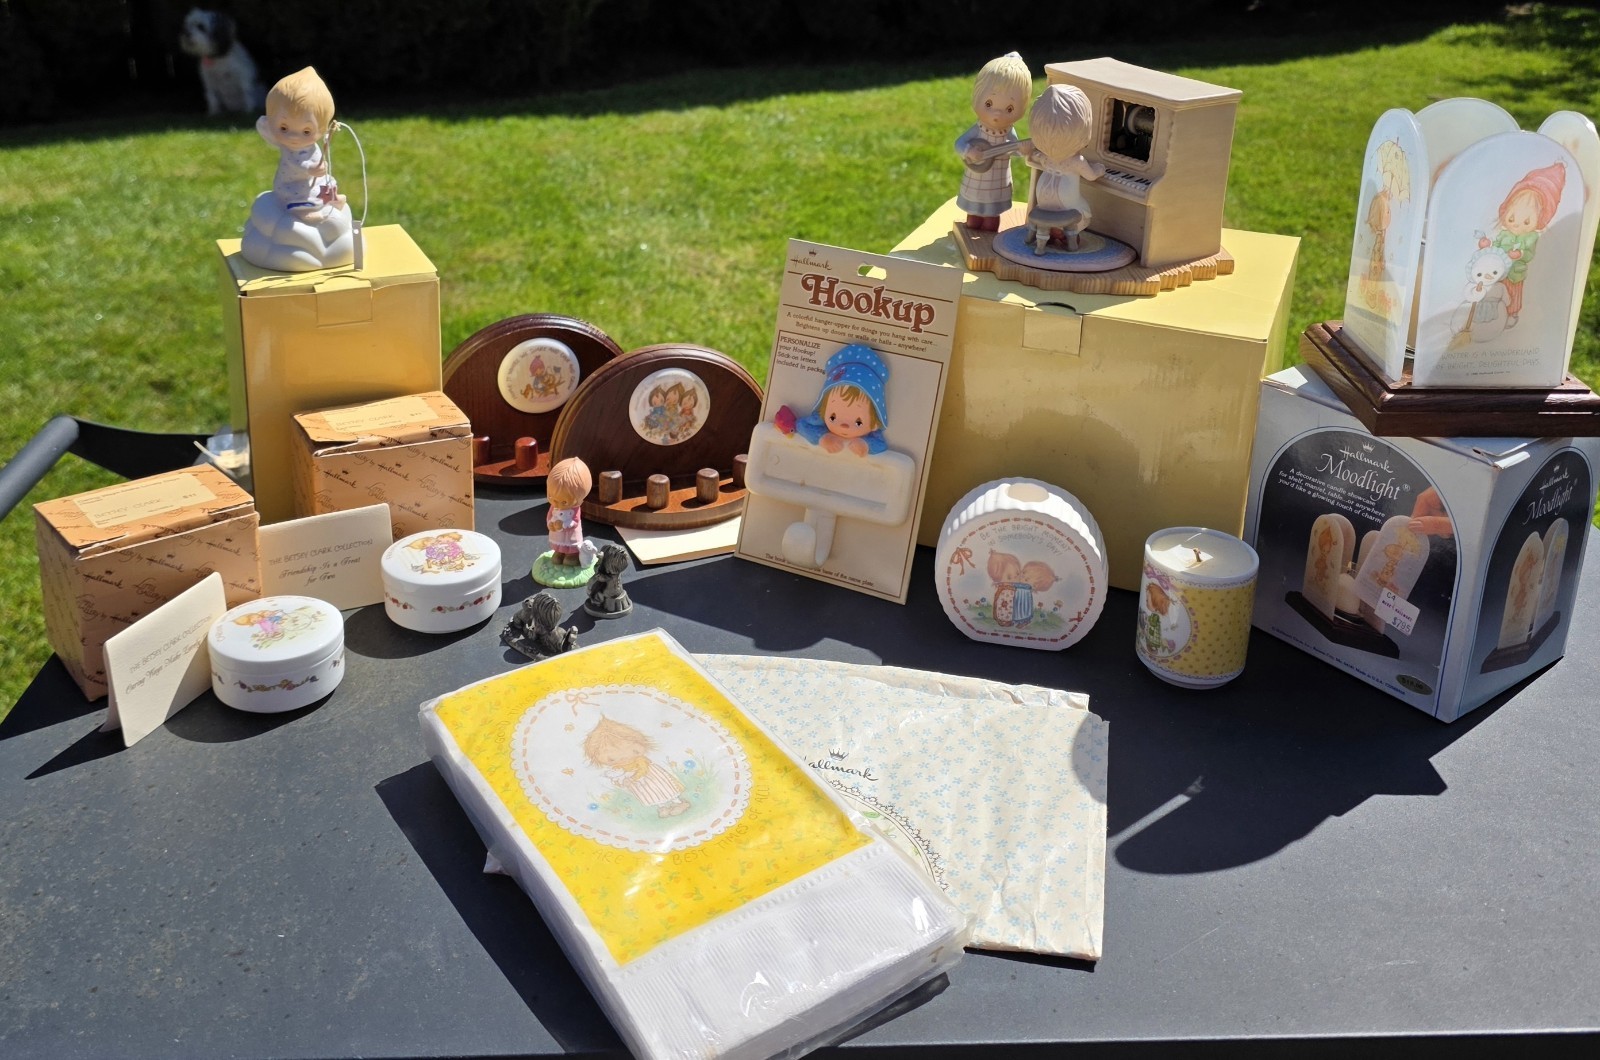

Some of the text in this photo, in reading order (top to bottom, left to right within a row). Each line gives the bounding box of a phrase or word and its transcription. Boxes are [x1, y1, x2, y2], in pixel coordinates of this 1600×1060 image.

[790, 256, 832, 270] Hallmark
[801, 273, 936, 333] Hookup
[792, 313, 814, 321] colorful
[860, 326, 878, 335] things
[891, 332, 905, 341] hang
[780, 336, 822, 350] PERSONALIZE
[806, 366, 826, 375] packag
[429, 455, 460, 473] Hallmark
[1339, 445, 1394, 473] Hallmark
[323, 469, 357, 489] Hallmark
[377, 463, 410, 481] Hallmark
[1315, 453, 1400, 501] Moodlight
[1539, 467, 1570, 494] Hallmark
[1278, 470, 1287, 478] for
[1355, 502, 1386, 518] anywhere
[1278, 478, 1295, 488] you'd
[1295, 483, 1306, 493] like
[1311, 492, 1336, 506] glowing
[1336, 502, 1353, 512] touch
[1295, 470, 1326, 487] decorative
[1326, 483, 1347, 495] candle
[1347, 491, 1376, 506] showcase
[397, 502, 429, 521] Hallmark
[206, 539, 242, 556] Hallmark
[992, 525, 1008, 534] THE
[1011, 524, 1039, 532] BRIGHT
[1041, 530, 1072, 552] MOMENT
[998, 532, 1045, 545] SOMEBODY'S
[268, 539, 373, 566] THE BETSEY CLARK COLLECTION
[146, 555, 185, 573] Hallmark
[279, 564, 317, 580] Friendship
[83, 571, 123, 589] Hallmark
[304, 575, 317, 587] for
[580, 674, 615, 684] GOOD
[803, 756, 879, 781] allmark
[671, 847, 709, 865] BEST
[714, 823, 749, 849] TIMES
